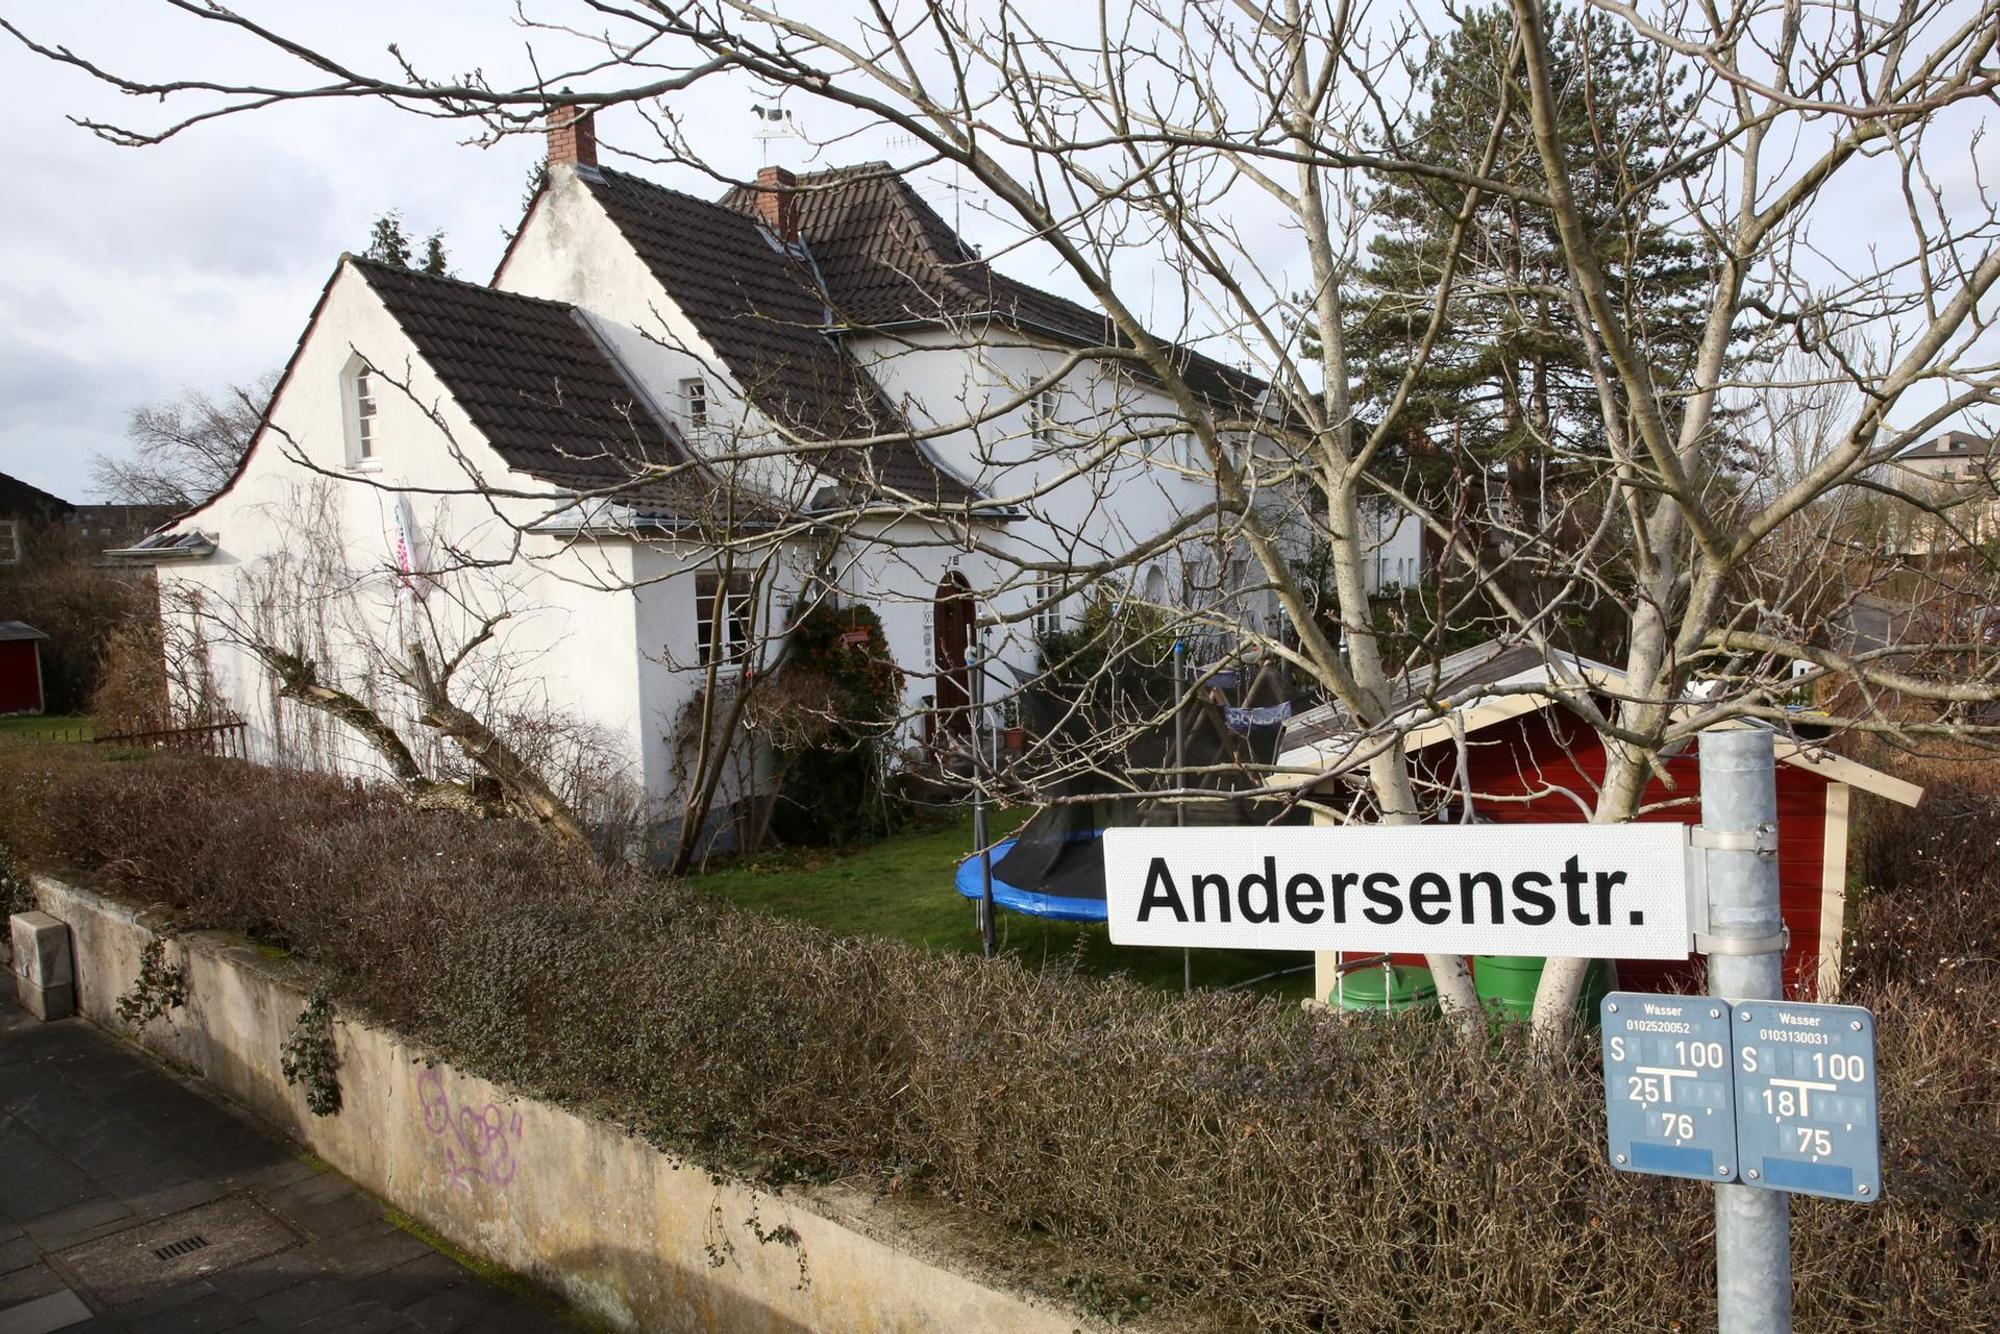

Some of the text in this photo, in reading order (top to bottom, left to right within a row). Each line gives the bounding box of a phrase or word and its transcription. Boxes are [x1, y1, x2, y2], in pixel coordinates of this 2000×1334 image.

[1136, 854, 1644, 926] Andersenstr.
[1644, 1003, 1683, 1017] Wasser
[1626, 1020, 1691, 1034] 0102520052
[1779, 1013, 1821, 1027] Wasser
[1760, 1028, 1828, 1046] 0103130031
[1610, 1036, 1723, 1069] S 100
[1742, 1046, 1865, 1083] S 100
